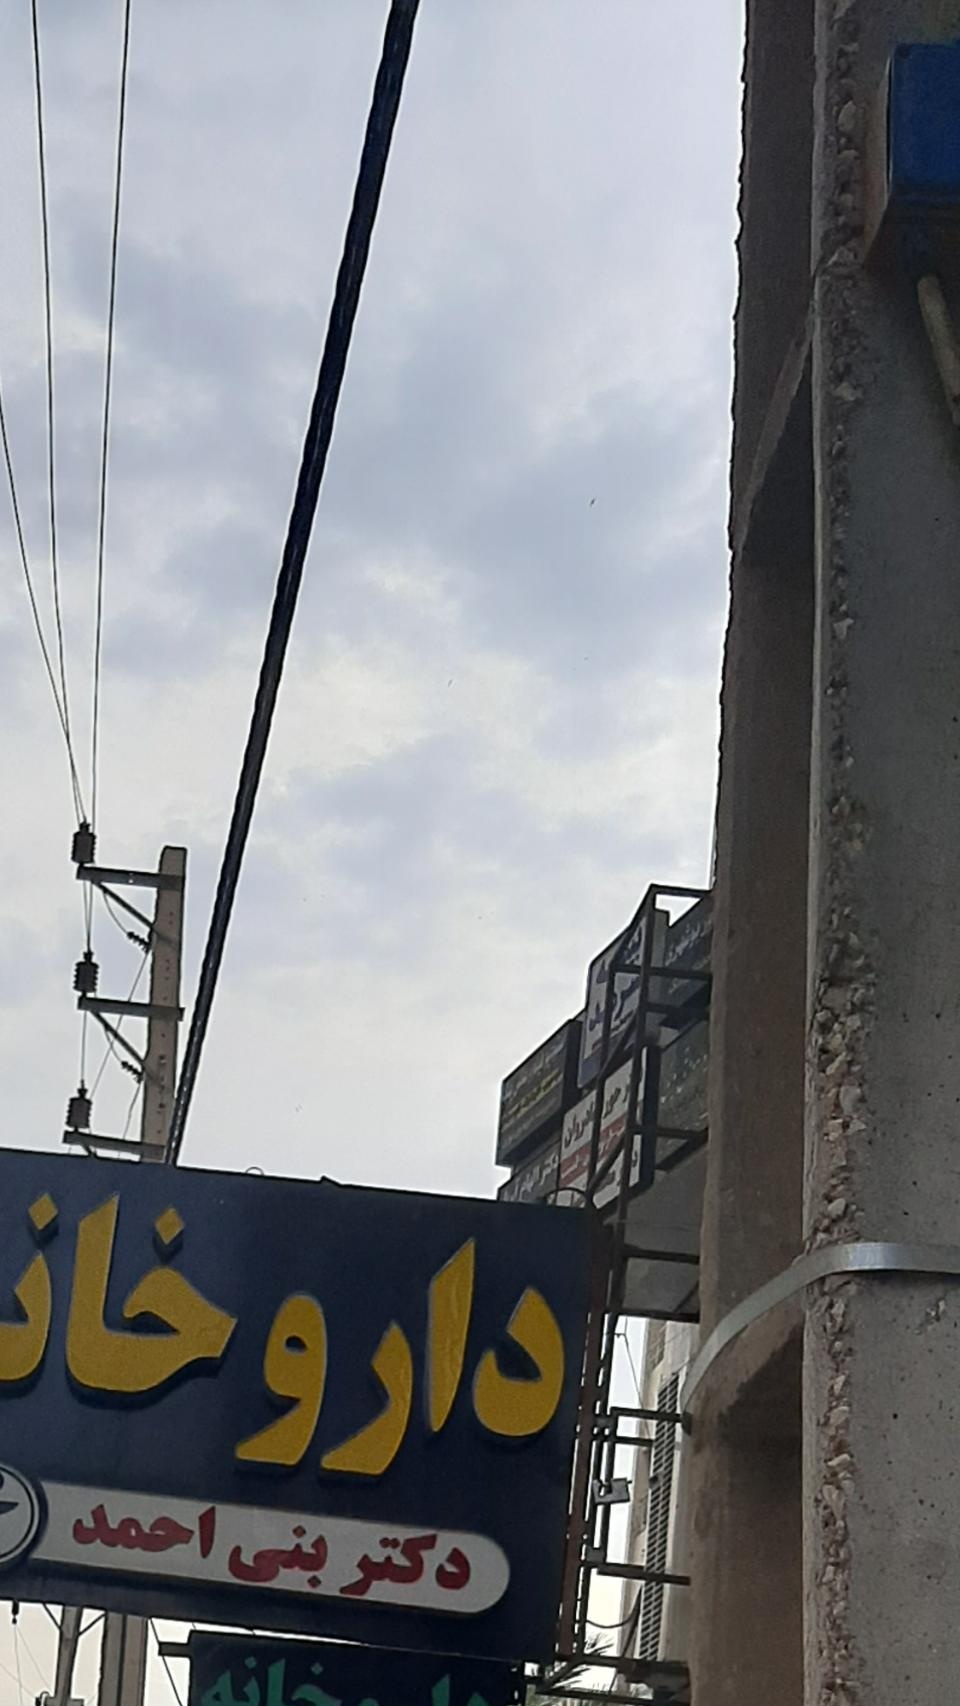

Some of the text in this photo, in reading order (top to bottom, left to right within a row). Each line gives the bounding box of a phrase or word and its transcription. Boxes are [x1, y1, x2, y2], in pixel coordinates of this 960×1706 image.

[71, 1503, 472, 1597] دکتر بنی احمد
